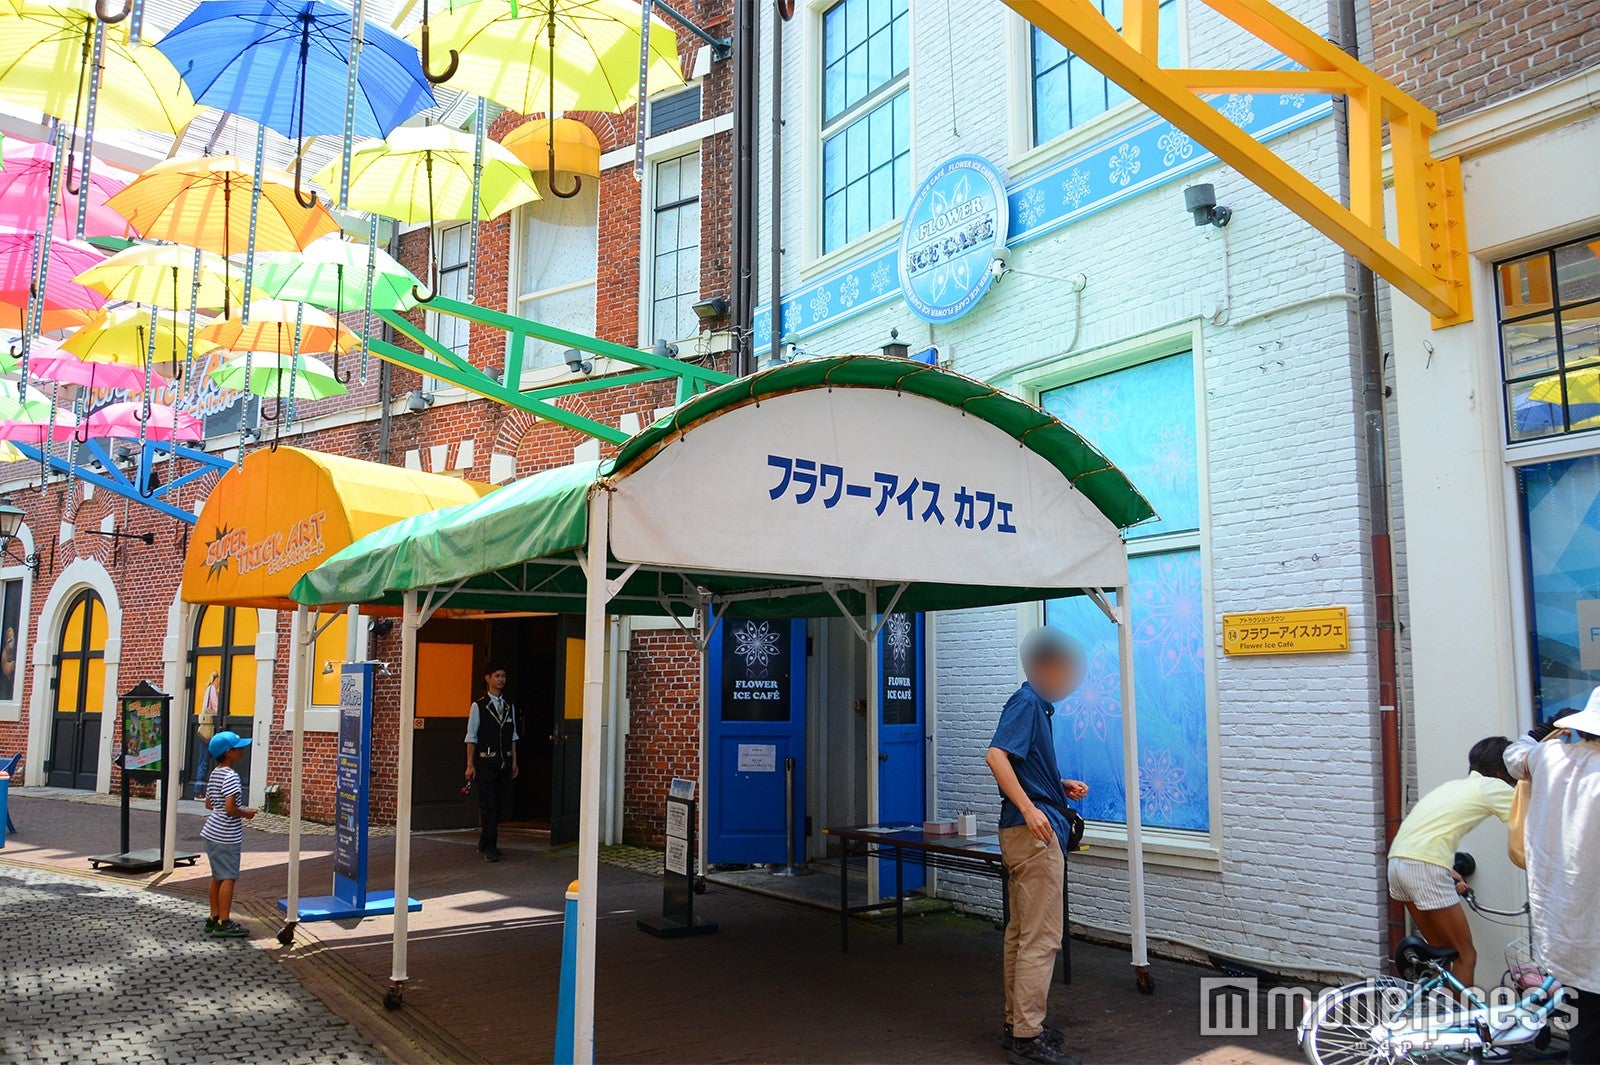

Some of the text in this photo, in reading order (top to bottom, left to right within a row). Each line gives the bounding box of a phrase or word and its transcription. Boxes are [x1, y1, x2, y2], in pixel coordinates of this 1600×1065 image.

[917, 196, 984, 241] FLOWER
[906, 214, 994, 274] ICE CAFÉ
[954, 485, 1017, 534] カフェ
[206, 527, 248, 566] SUPER
[236, 530, 282, 575] TRICK
[286, 510, 327, 553] ART
[733, 690, 780, 700] ICE CAFÉ
[735, 680, 778, 689] FLOWER
[887, 689, 912, 700] ICE CAFÉ
[888, 676, 911, 686] FLOWER
